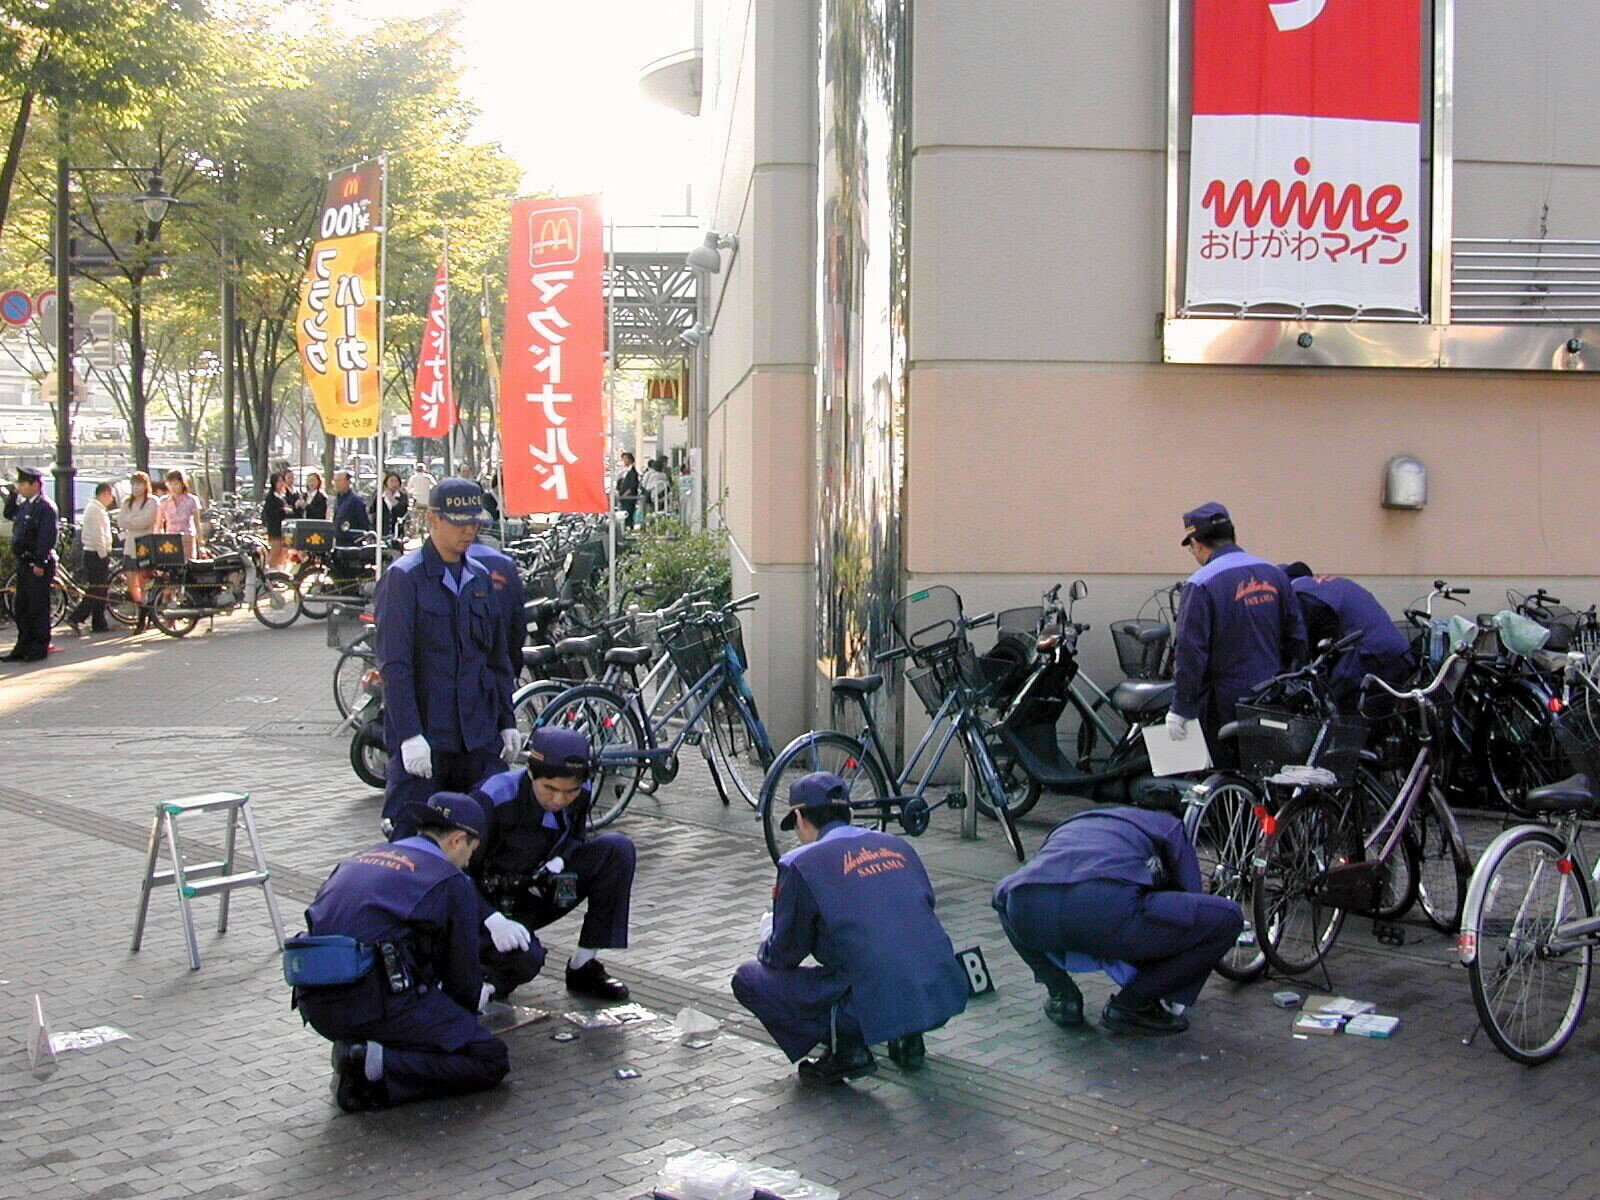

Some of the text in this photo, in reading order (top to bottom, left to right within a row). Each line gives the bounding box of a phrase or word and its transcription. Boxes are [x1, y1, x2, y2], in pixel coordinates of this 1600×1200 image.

[1202, 156, 1409, 233] mine
[1199, 229, 1408, 265] おけがわマイン
[446, 495, 482, 508] POLICE
[856, 859, 905, 878] SAITAMA
[962, 951, 988, 994] B
